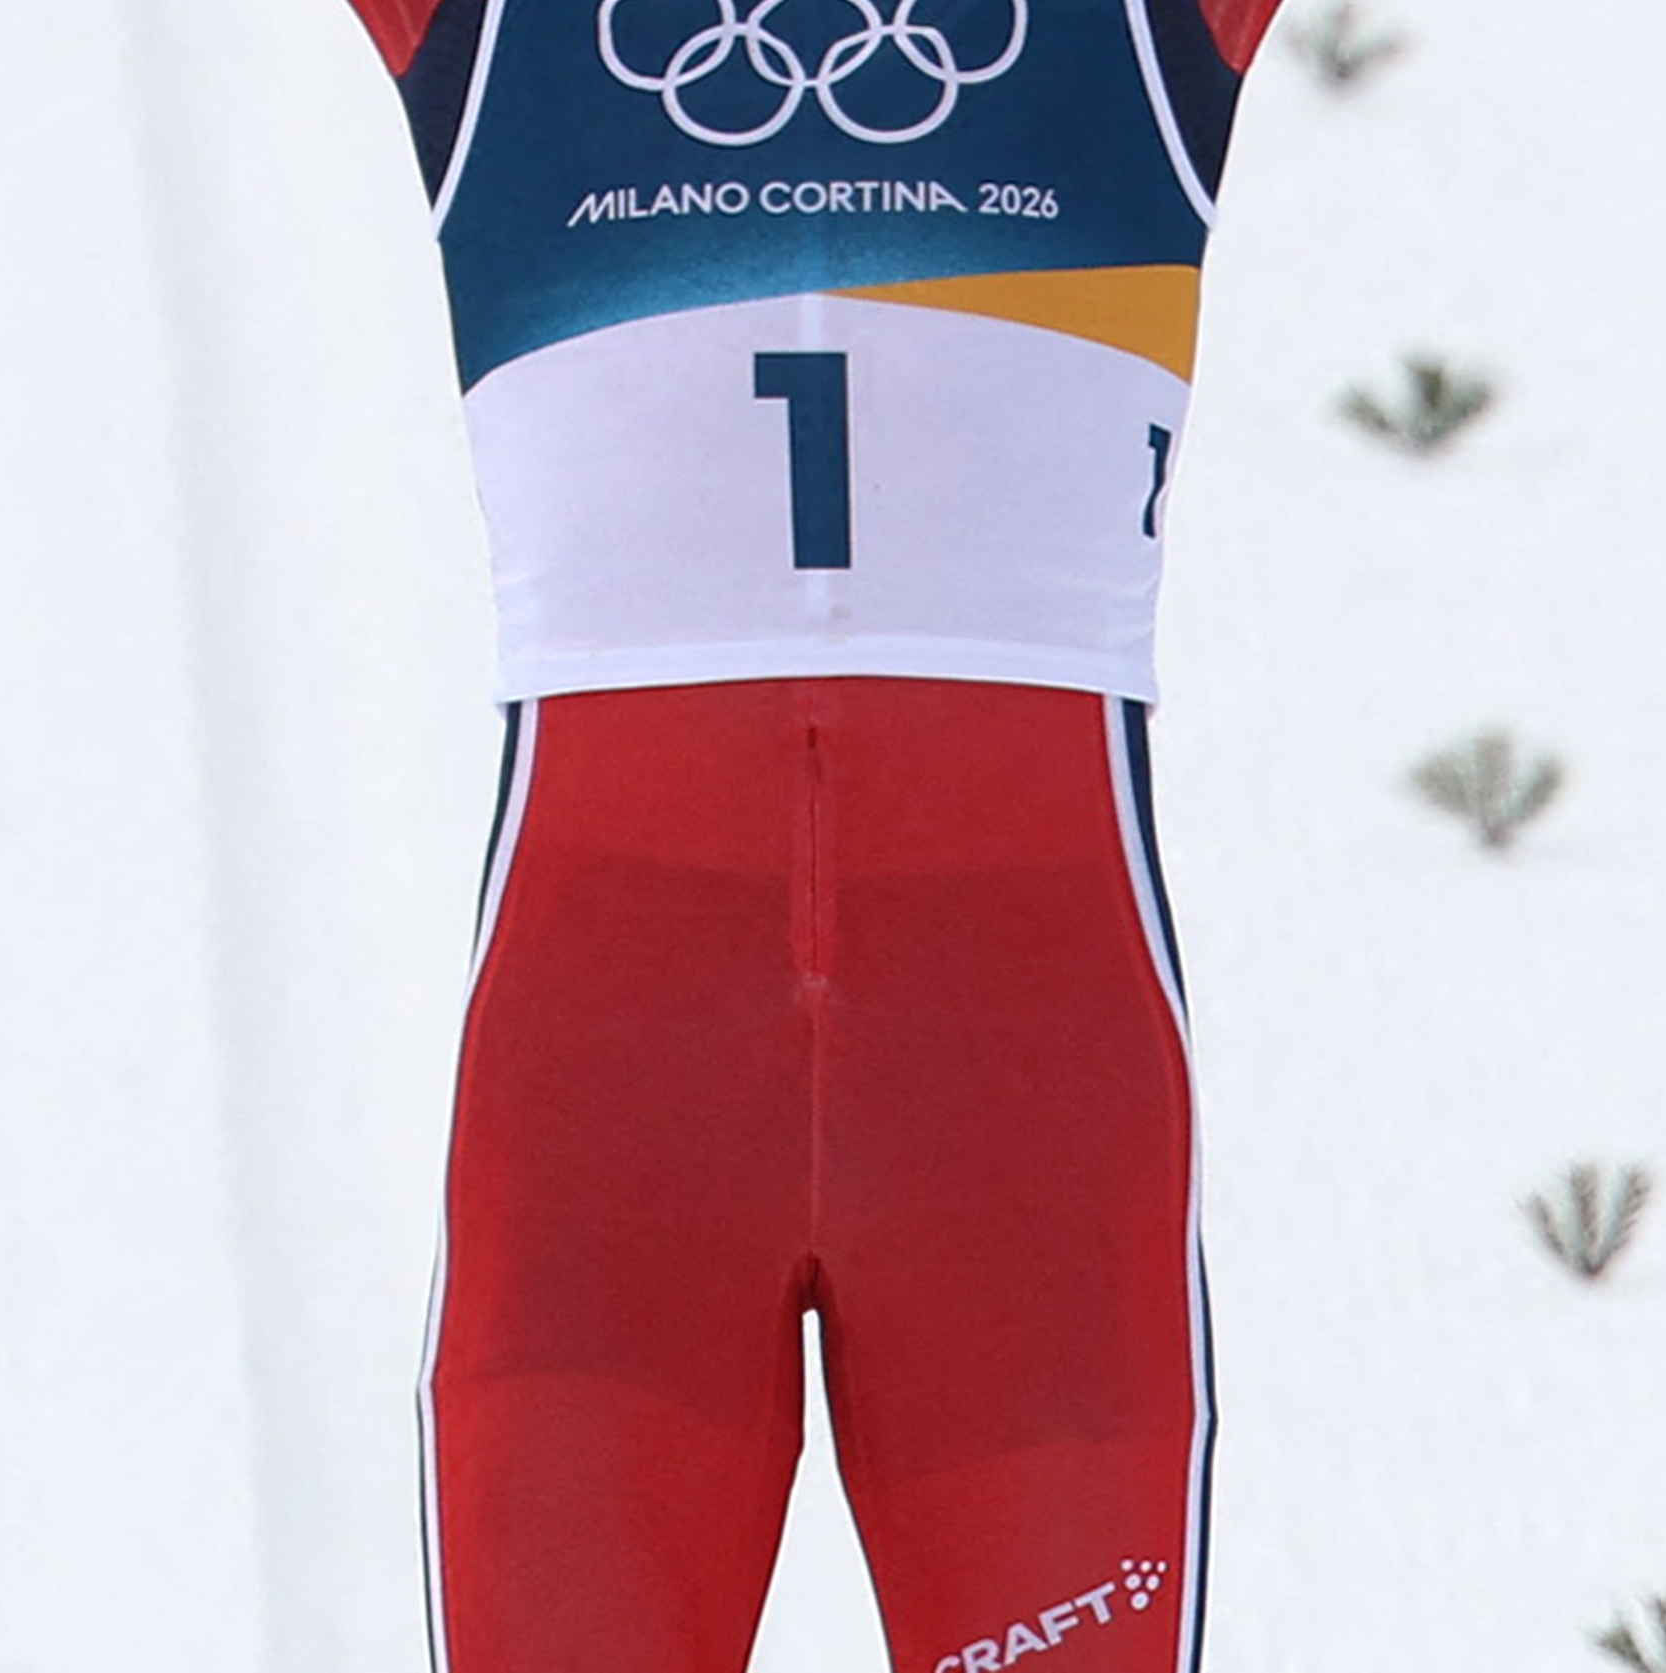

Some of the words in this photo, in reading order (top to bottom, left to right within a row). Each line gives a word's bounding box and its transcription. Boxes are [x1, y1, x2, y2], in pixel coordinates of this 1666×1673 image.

[567, 181, 751, 227] MILANO
[759, 180, 968, 214] CORTINA
[978, 183, 1060, 219] 2026
[754, 352, 851, 569] 1
[1144, 422, 1172, 540] 1
